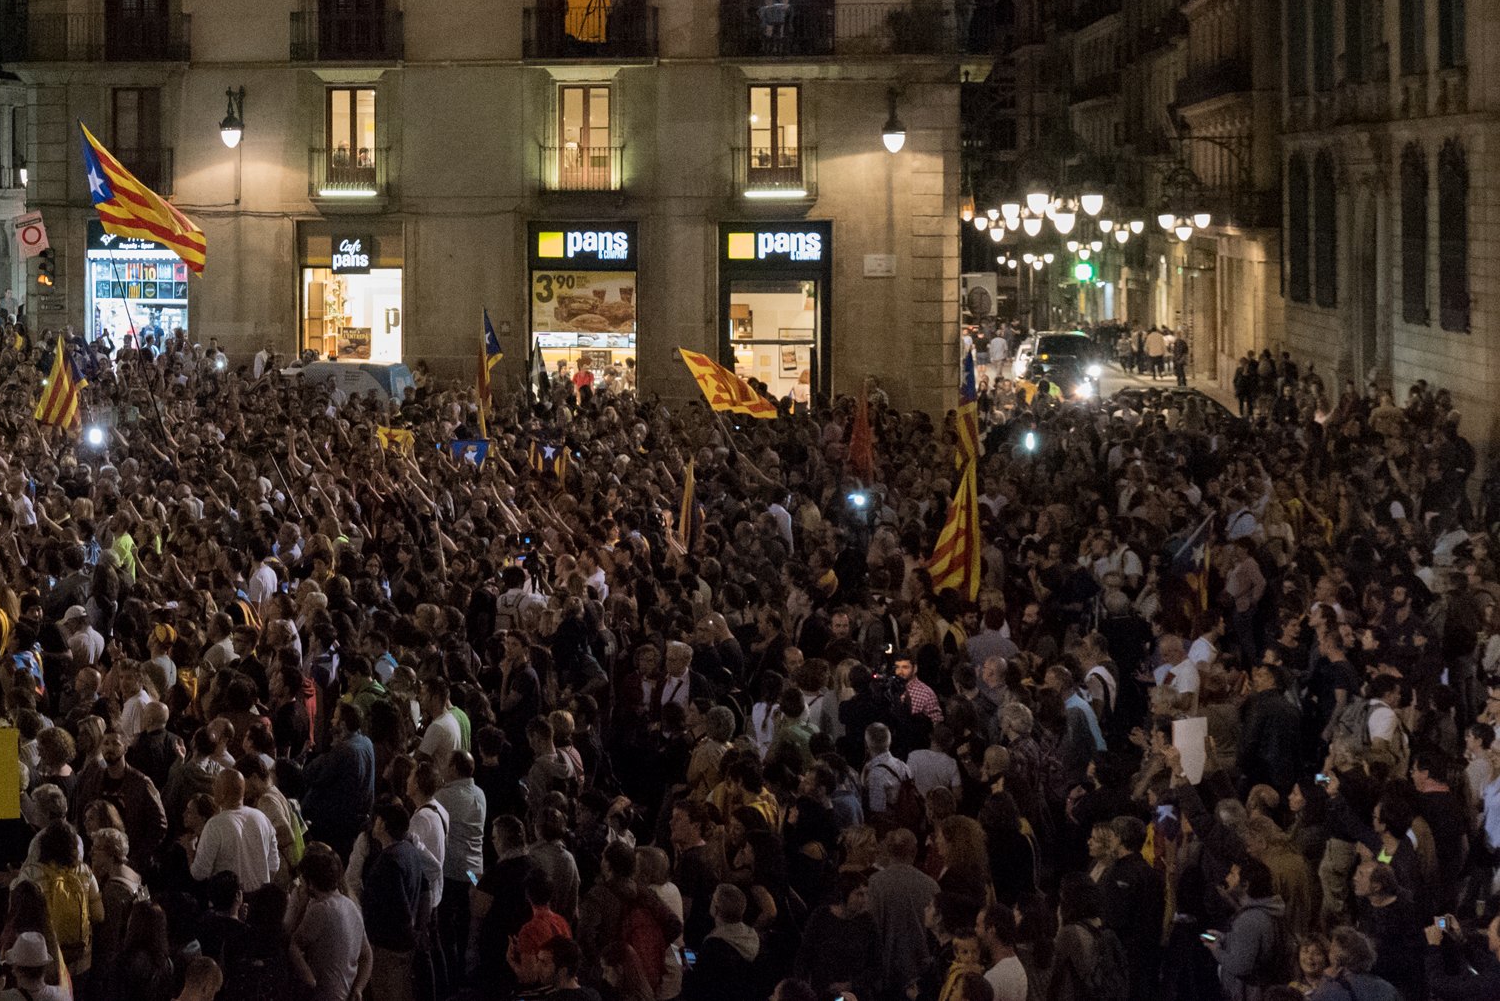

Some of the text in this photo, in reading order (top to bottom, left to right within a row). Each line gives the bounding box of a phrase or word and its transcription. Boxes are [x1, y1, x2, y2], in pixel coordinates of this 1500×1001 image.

[566, 231, 628, 258] pans
[757, 232, 821, 260] pans
[332, 253, 369, 270] pans
[143, 267, 156, 280] 10
